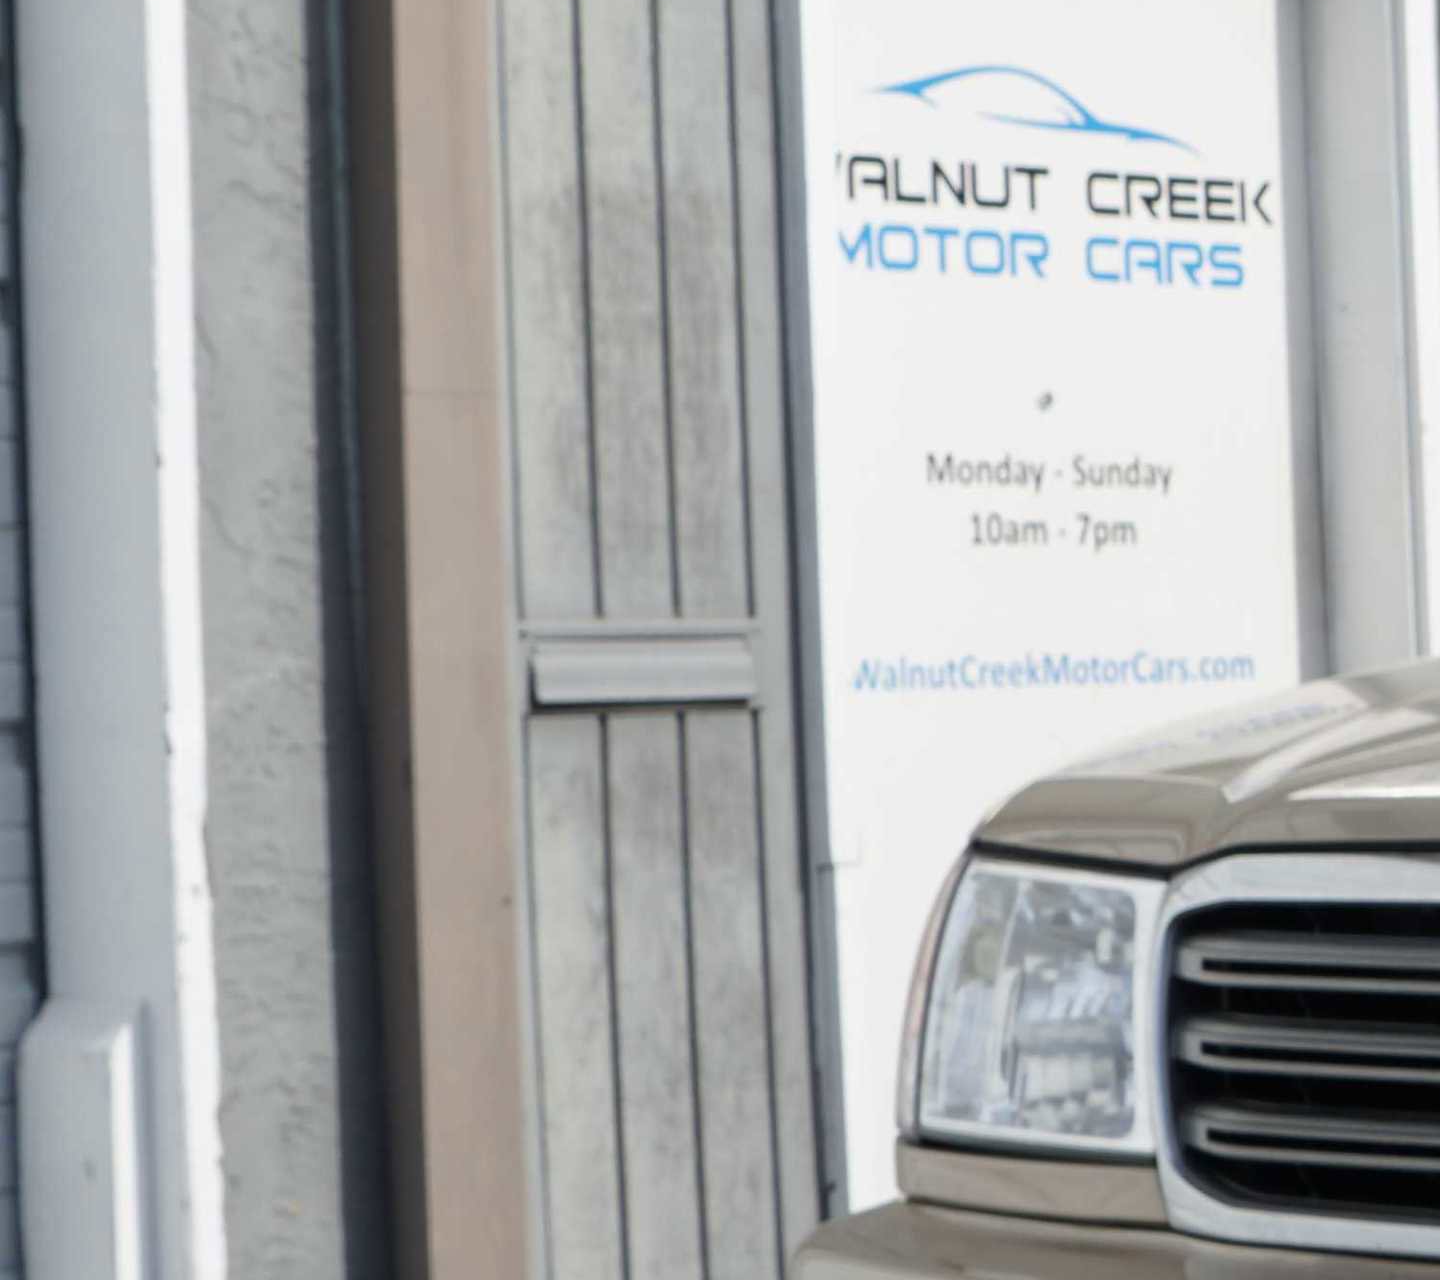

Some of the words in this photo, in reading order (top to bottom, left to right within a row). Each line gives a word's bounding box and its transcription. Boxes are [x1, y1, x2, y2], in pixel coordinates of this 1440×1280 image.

[836, 151, 1049, 211] ALNUT
[1086, 171, 1272, 224] CREEK
[1085, 236, 1245, 288] CARS
[926, 452, 1045, 494] Monday
[1071, 454, 1173, 495] Sunday
[971, 513, 1049, 547] 10am
[1077, 512, 1138, 553] 7pm
